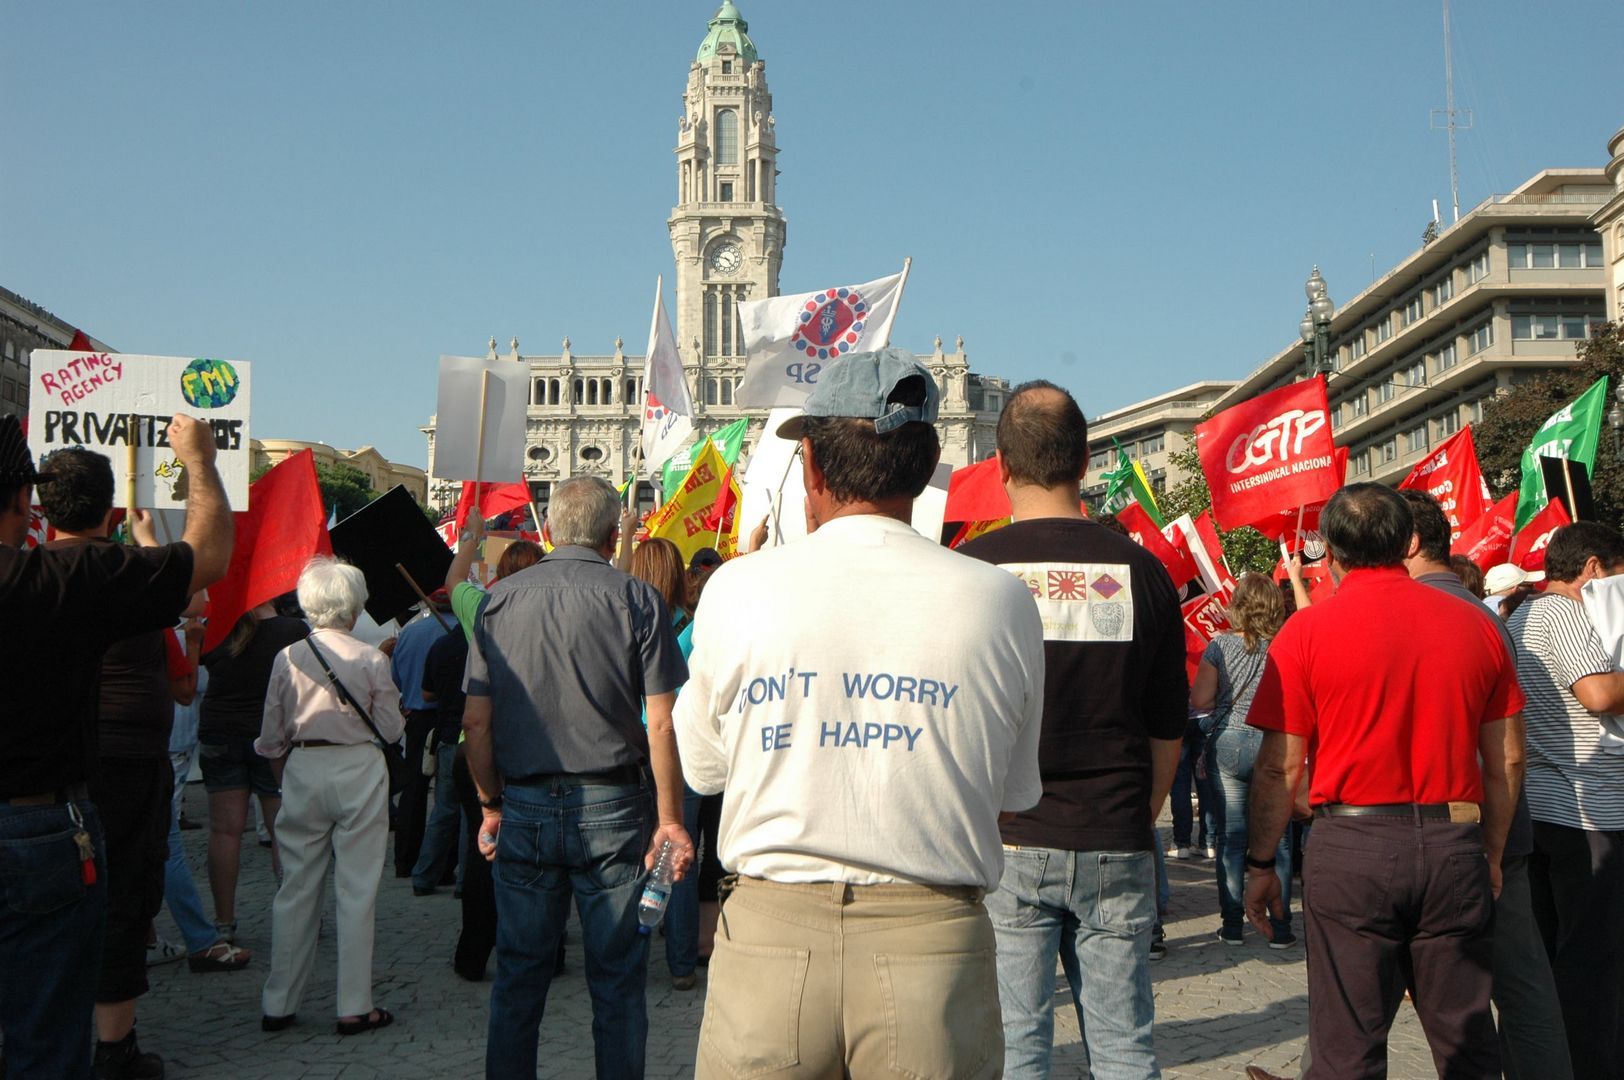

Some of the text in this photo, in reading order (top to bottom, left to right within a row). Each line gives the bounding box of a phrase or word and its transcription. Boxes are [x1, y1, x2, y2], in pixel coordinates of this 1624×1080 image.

[40, 353, 112, 395] RATING
[60, 362, 123, 406] AGENCY
[181, 364, 235, 402] FMI
[1226, 409, 1326, 474] CGTP
[1230, 455, 1332, 493] INTERSINDICAL NACIONA
[843, 672, 959, 709] WORRY
[761, 721, 923, 752] BE HAPPY
